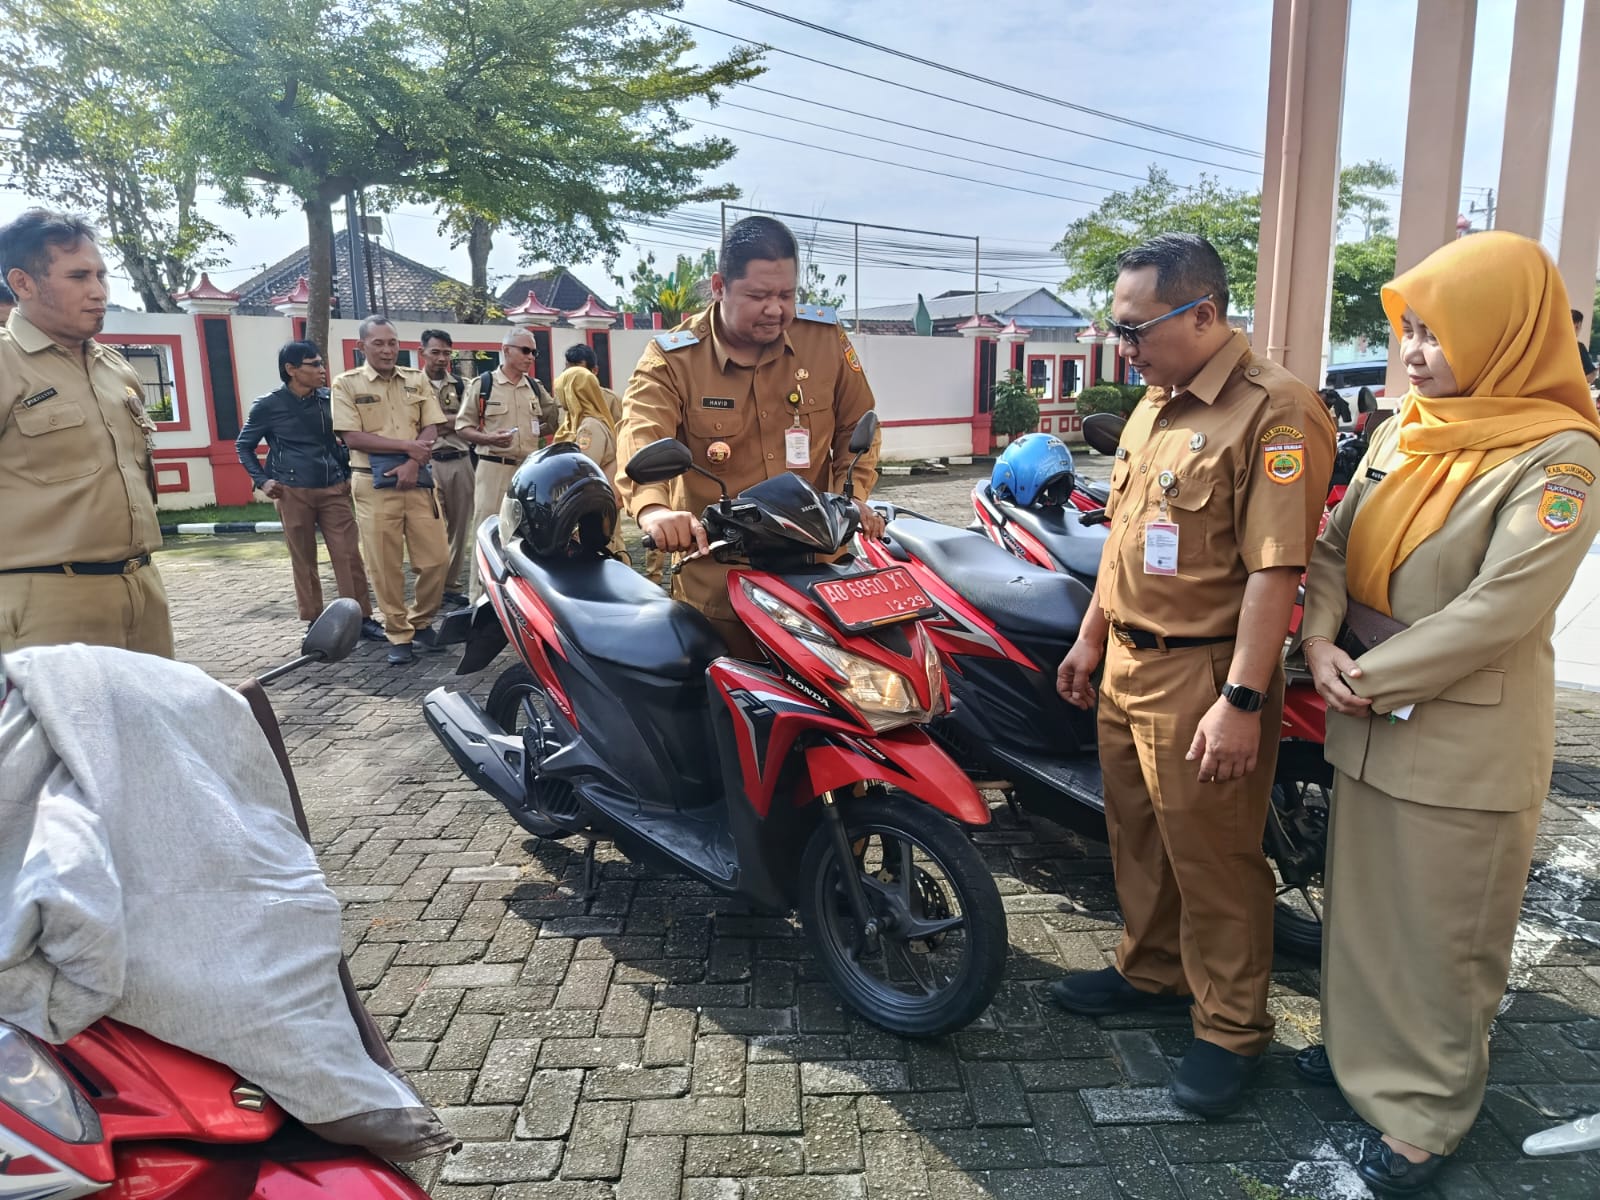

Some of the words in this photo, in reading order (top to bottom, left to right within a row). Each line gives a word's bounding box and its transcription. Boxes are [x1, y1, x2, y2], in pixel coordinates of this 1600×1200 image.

[824, 584, 850, 603] AD
[846, 577, 889, 599] 6850
[886, 571, 911, 591] XT
[786, 674, 830, 708] HONDA
